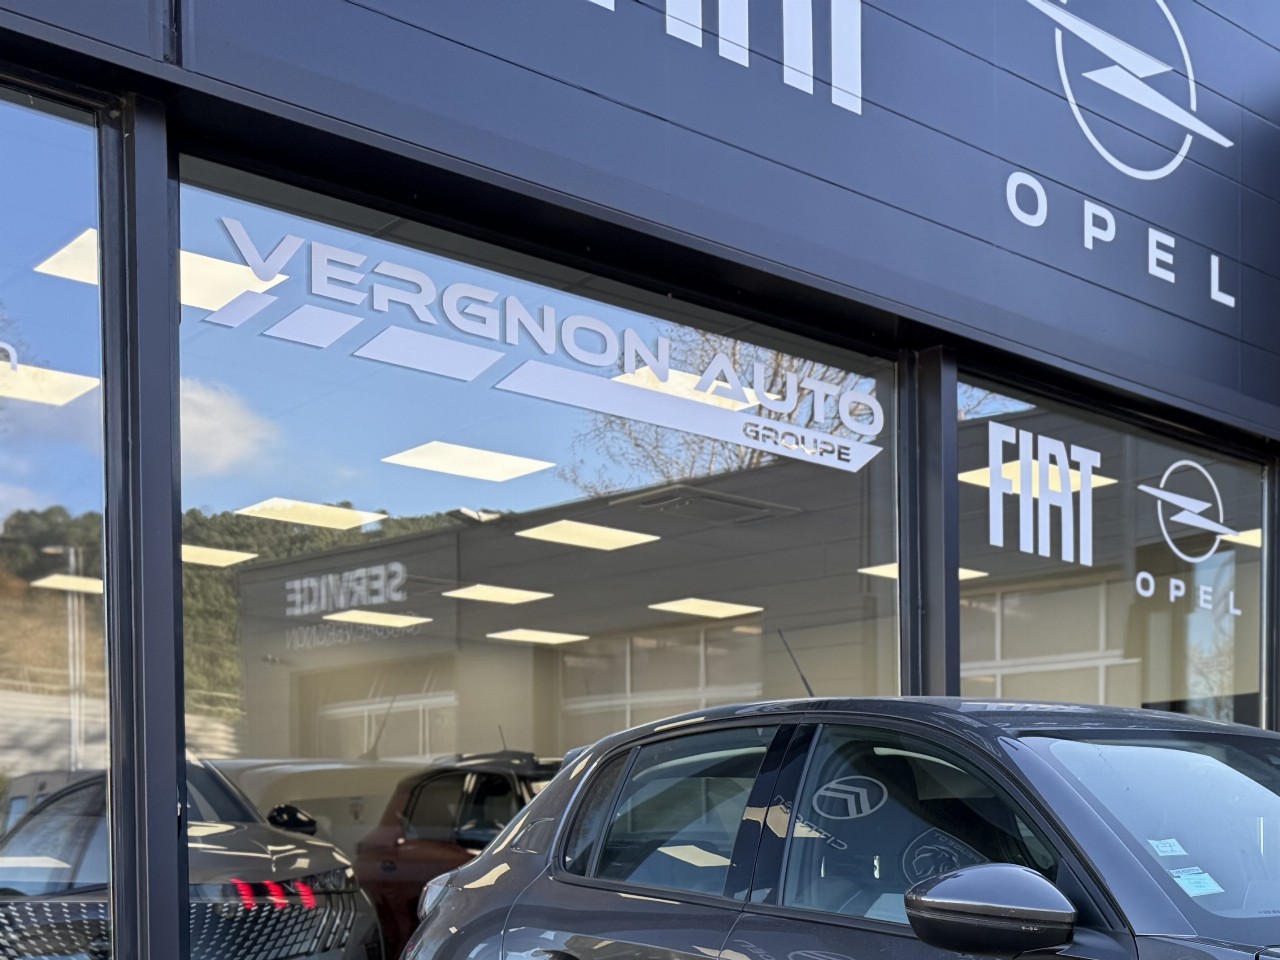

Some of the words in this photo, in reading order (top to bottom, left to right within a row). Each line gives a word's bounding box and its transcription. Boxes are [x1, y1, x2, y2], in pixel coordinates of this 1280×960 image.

[1006, 171, 1235, 308] OPEL
[220, 216, 670, 382] VERGNON
[694, 353, 884, 438] AUTO
[743, 421, 852, 464] GROUPE
[988, 420, 1100, 566] FIAT
[1135, 570, 1242, 616] OPEL
